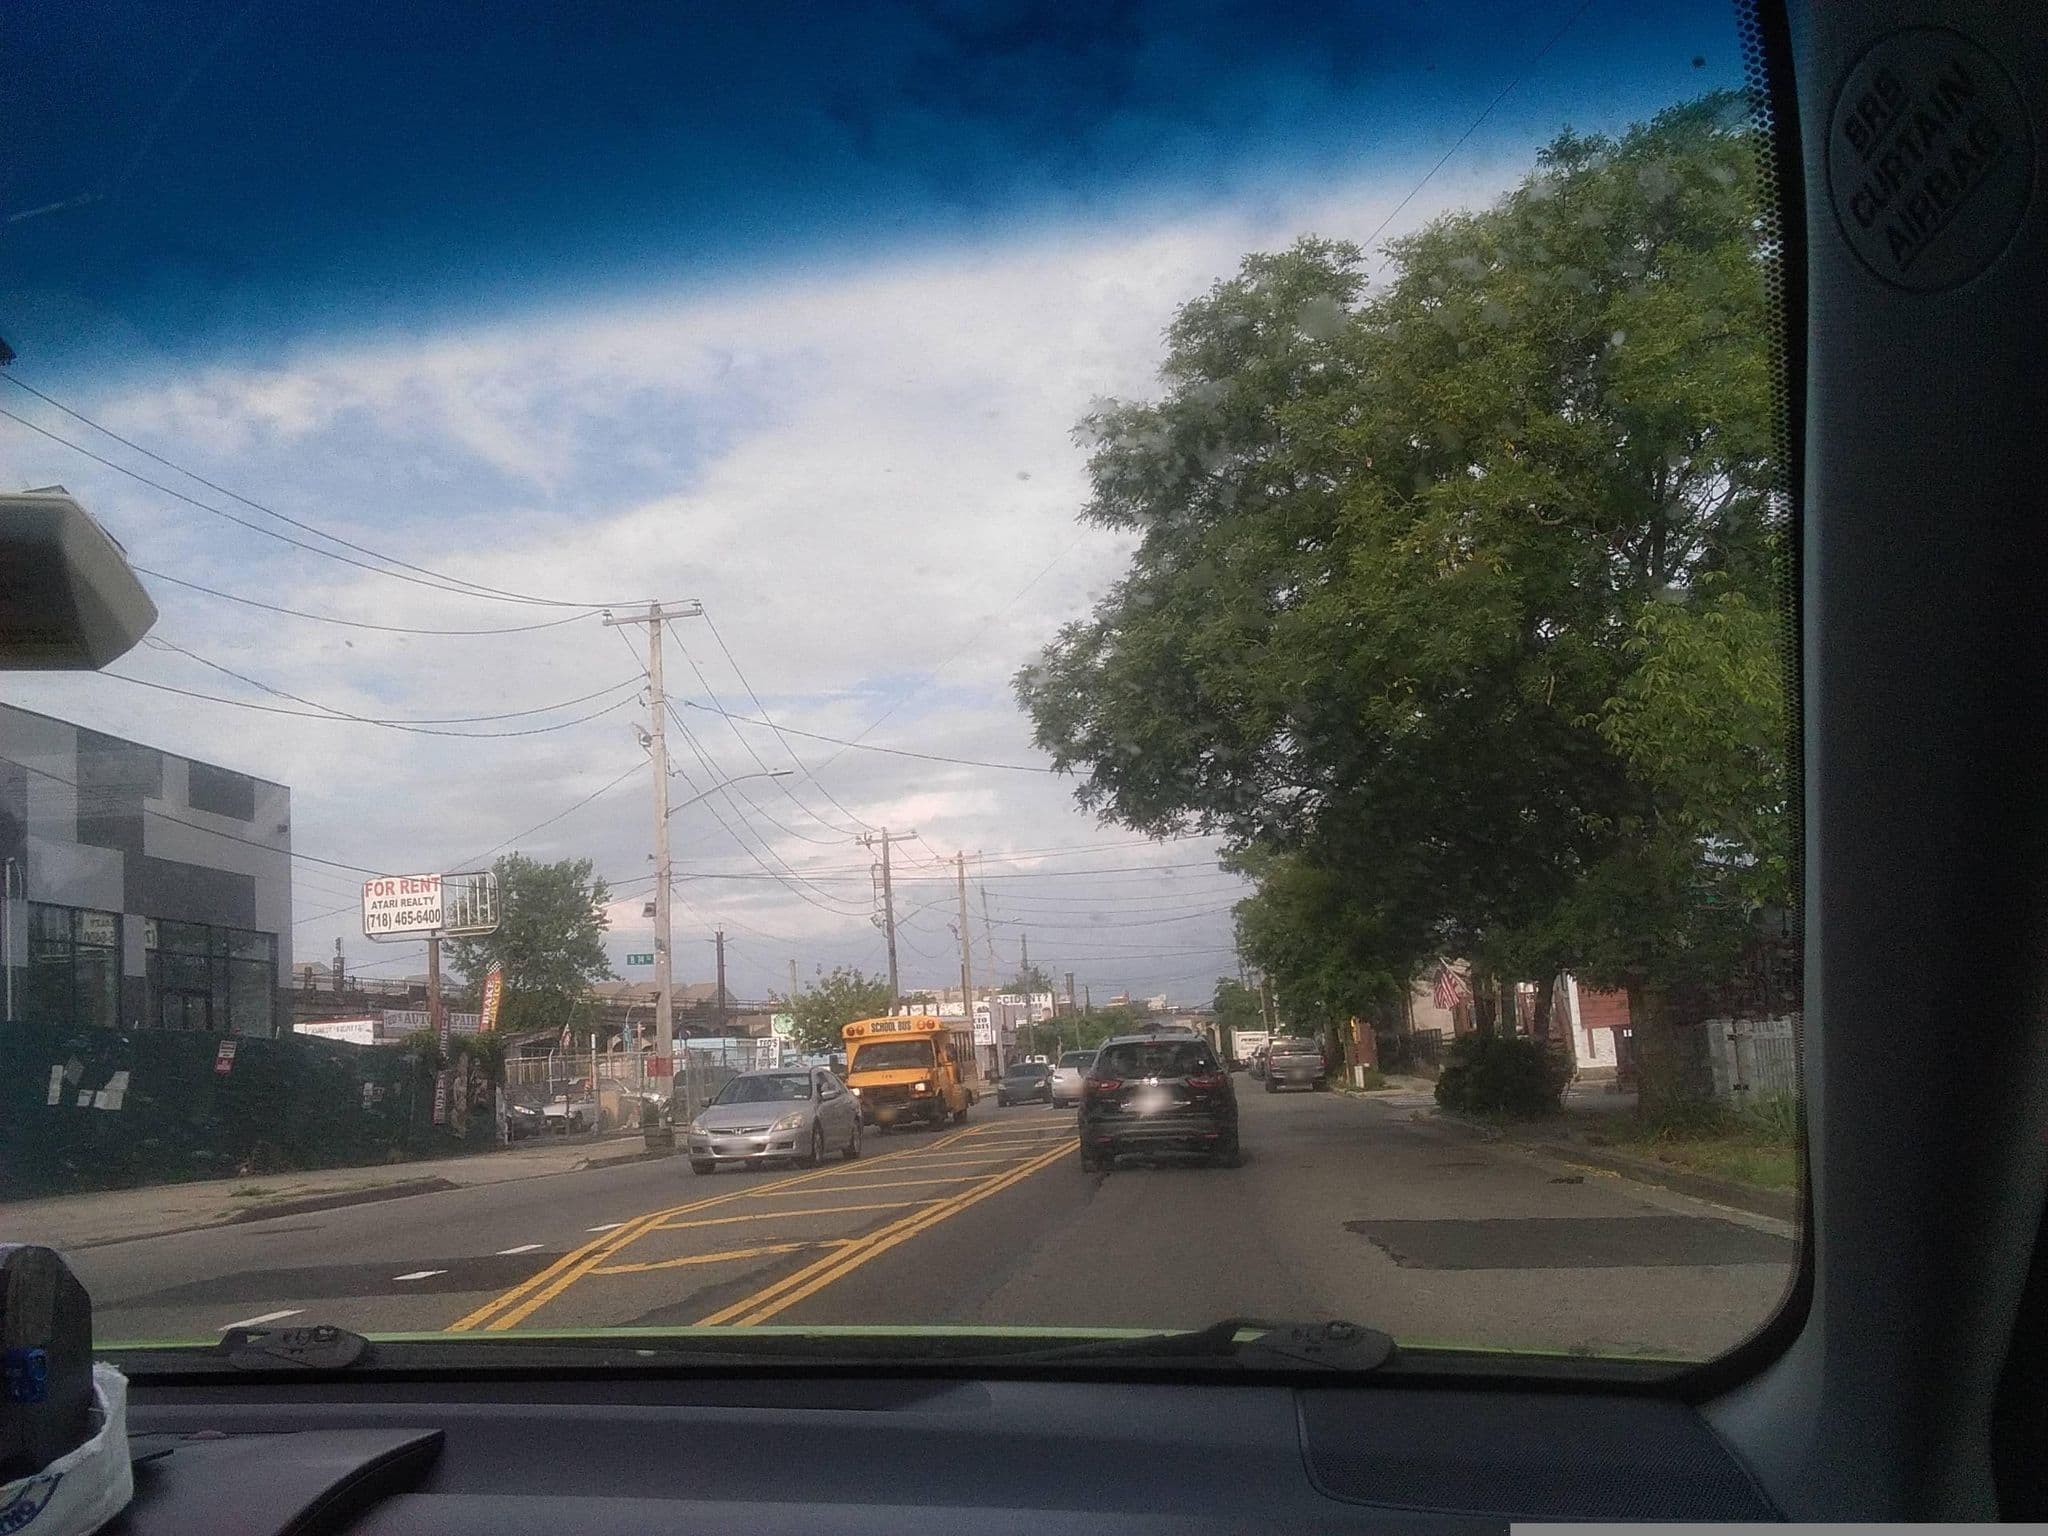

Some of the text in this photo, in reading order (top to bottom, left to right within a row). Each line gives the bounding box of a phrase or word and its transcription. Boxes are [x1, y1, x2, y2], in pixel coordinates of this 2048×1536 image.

[1849, 57, 1975, 230] CURTAIN
[1884, 112, 2000, 264] AIRBAG
[365, 877, 440, 897] FOR RENT
[371, 896, 435, 910] ATARI REALTY
[366, 908, 441, 931] (718) 465-6400
[481, 979, 495, 1024] BRAKE
[988, 993, 1049, 1004] CCIDENT?
[871, 1020, 912, 1033] SCHOOL BUS
